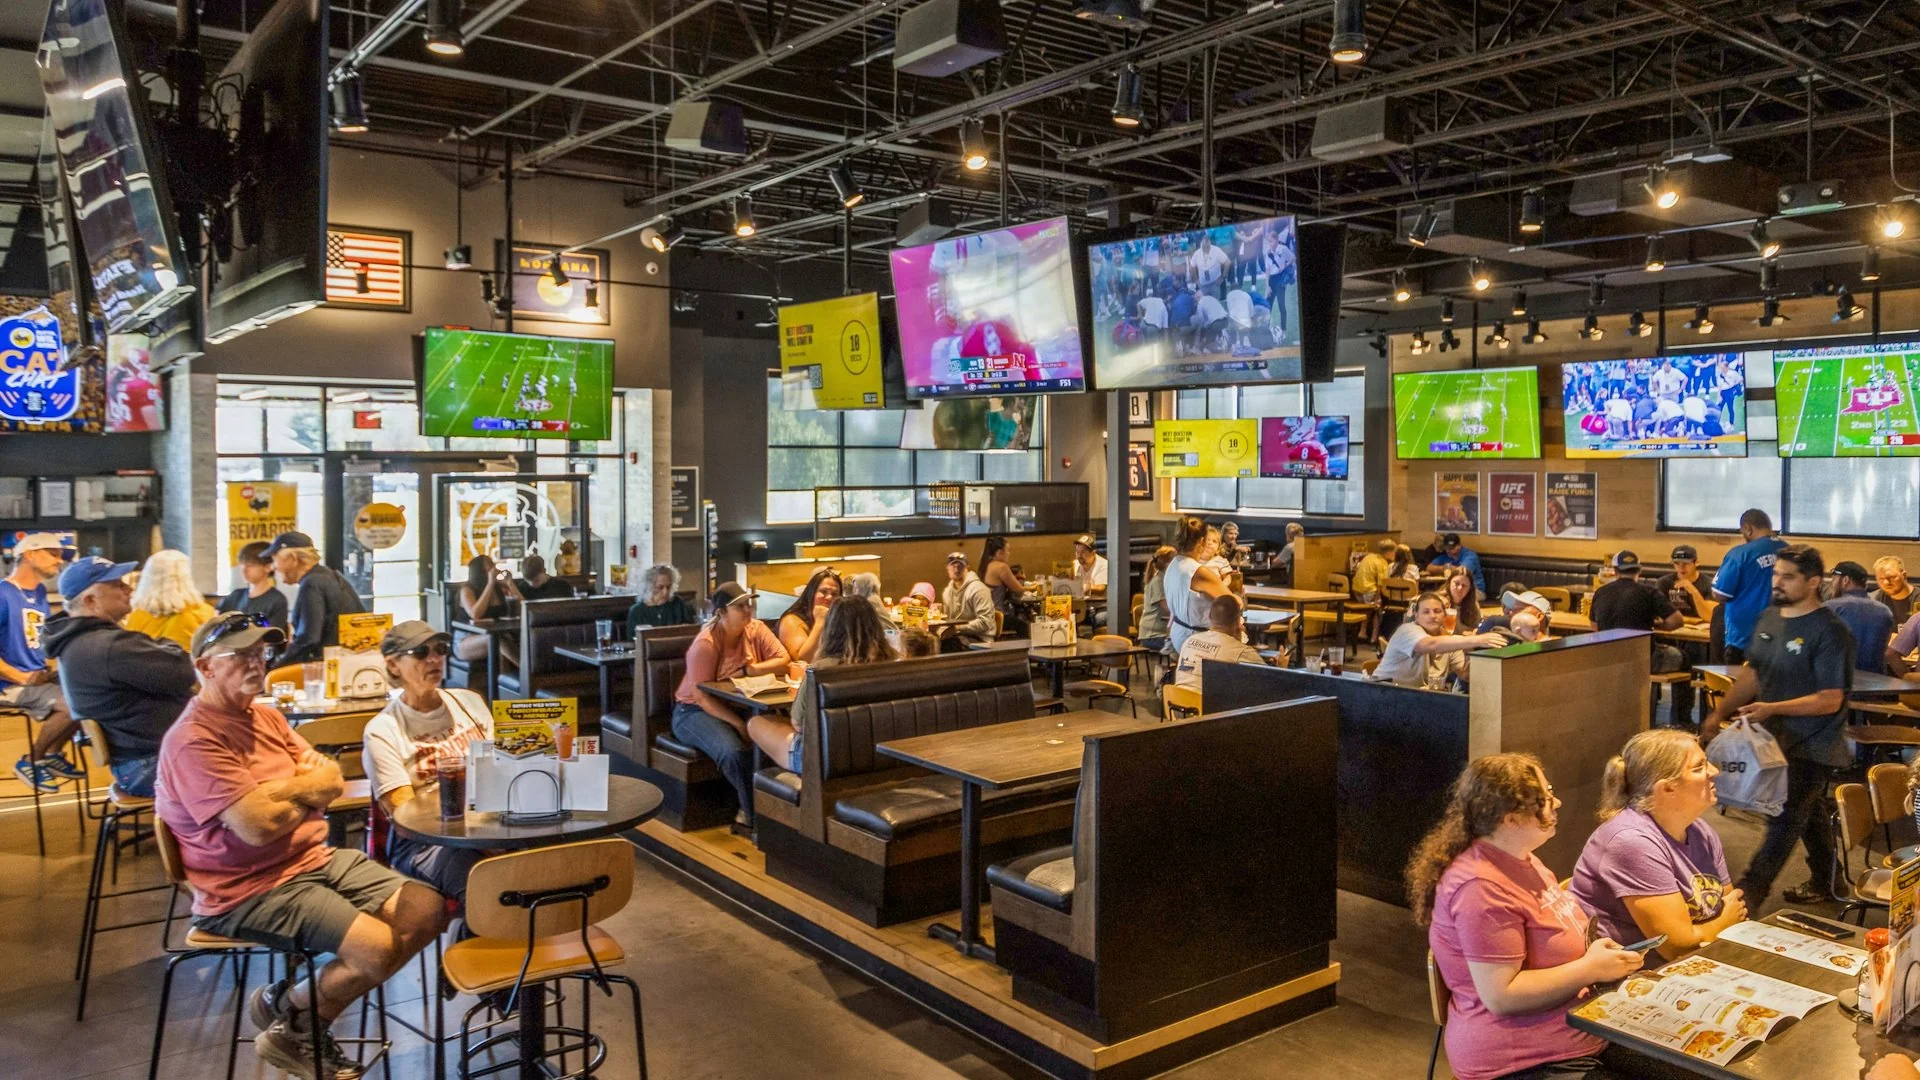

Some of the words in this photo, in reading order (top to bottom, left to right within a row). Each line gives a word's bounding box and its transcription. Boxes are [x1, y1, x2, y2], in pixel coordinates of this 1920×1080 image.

[850, 334, 860, 352] 10
[6, 370, 68, 388] CHAT
[1060, 379, 1072, 388] FS1
[1229, 439, 1238, 448] 10
[1444, 473, 1462, 482] HAPPY
[1500, 483, 1525, 494] UFC
[229, 522, 296, 540] REWARDS
[508, 706, 565, 714] THROWBACK
